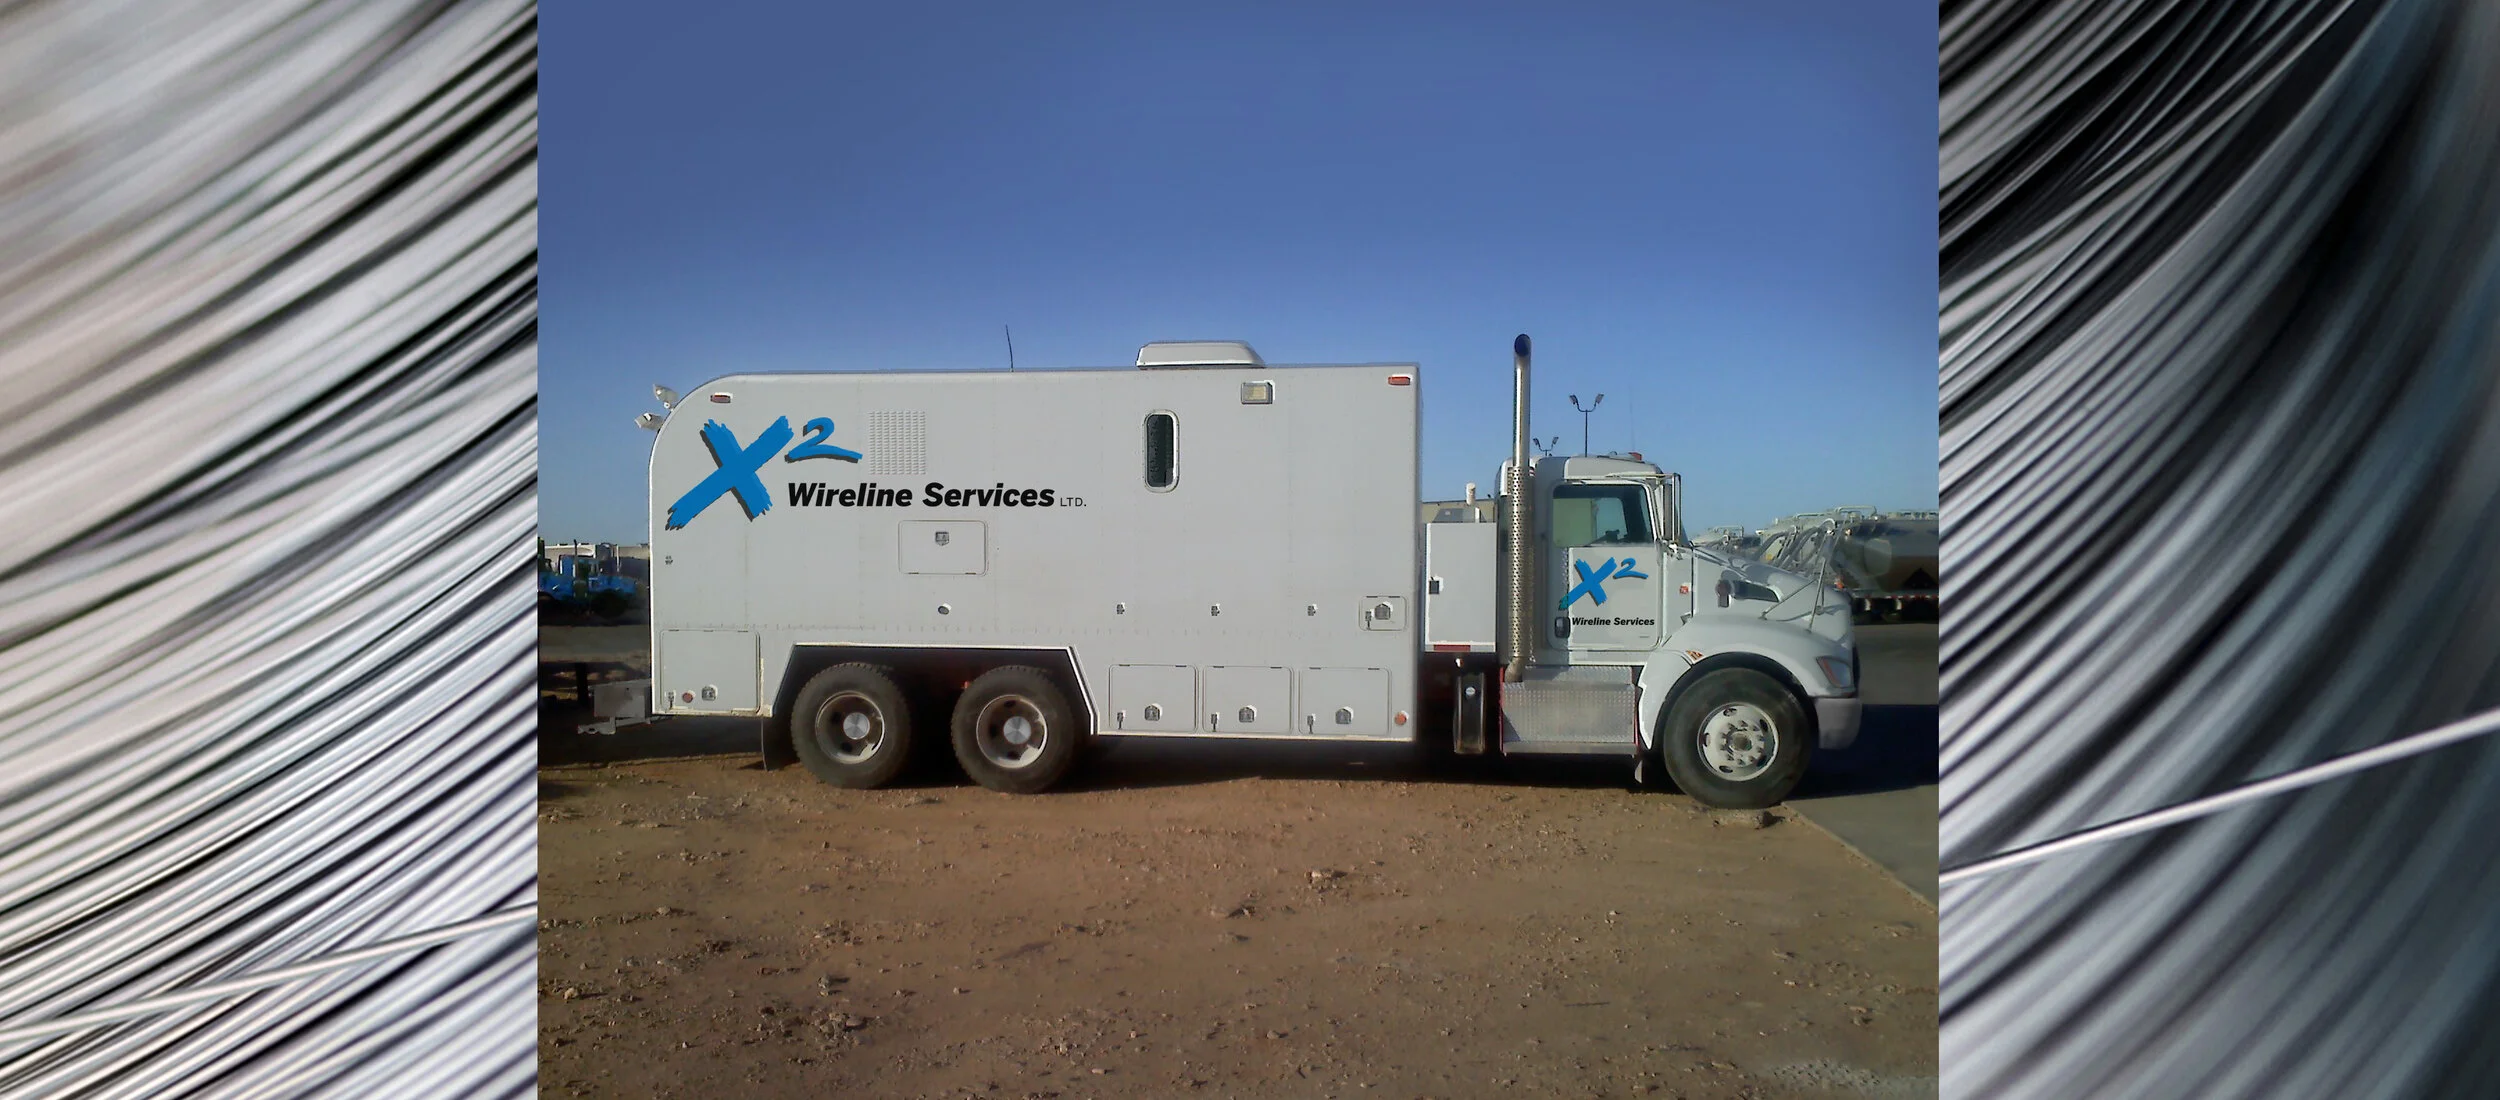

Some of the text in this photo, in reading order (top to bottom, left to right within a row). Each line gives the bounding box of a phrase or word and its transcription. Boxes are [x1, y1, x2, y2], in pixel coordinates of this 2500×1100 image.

[787, 482, 1088, 508] Wireline Services LTD.
[1572, 616, 1655, 626] Wireline Services
